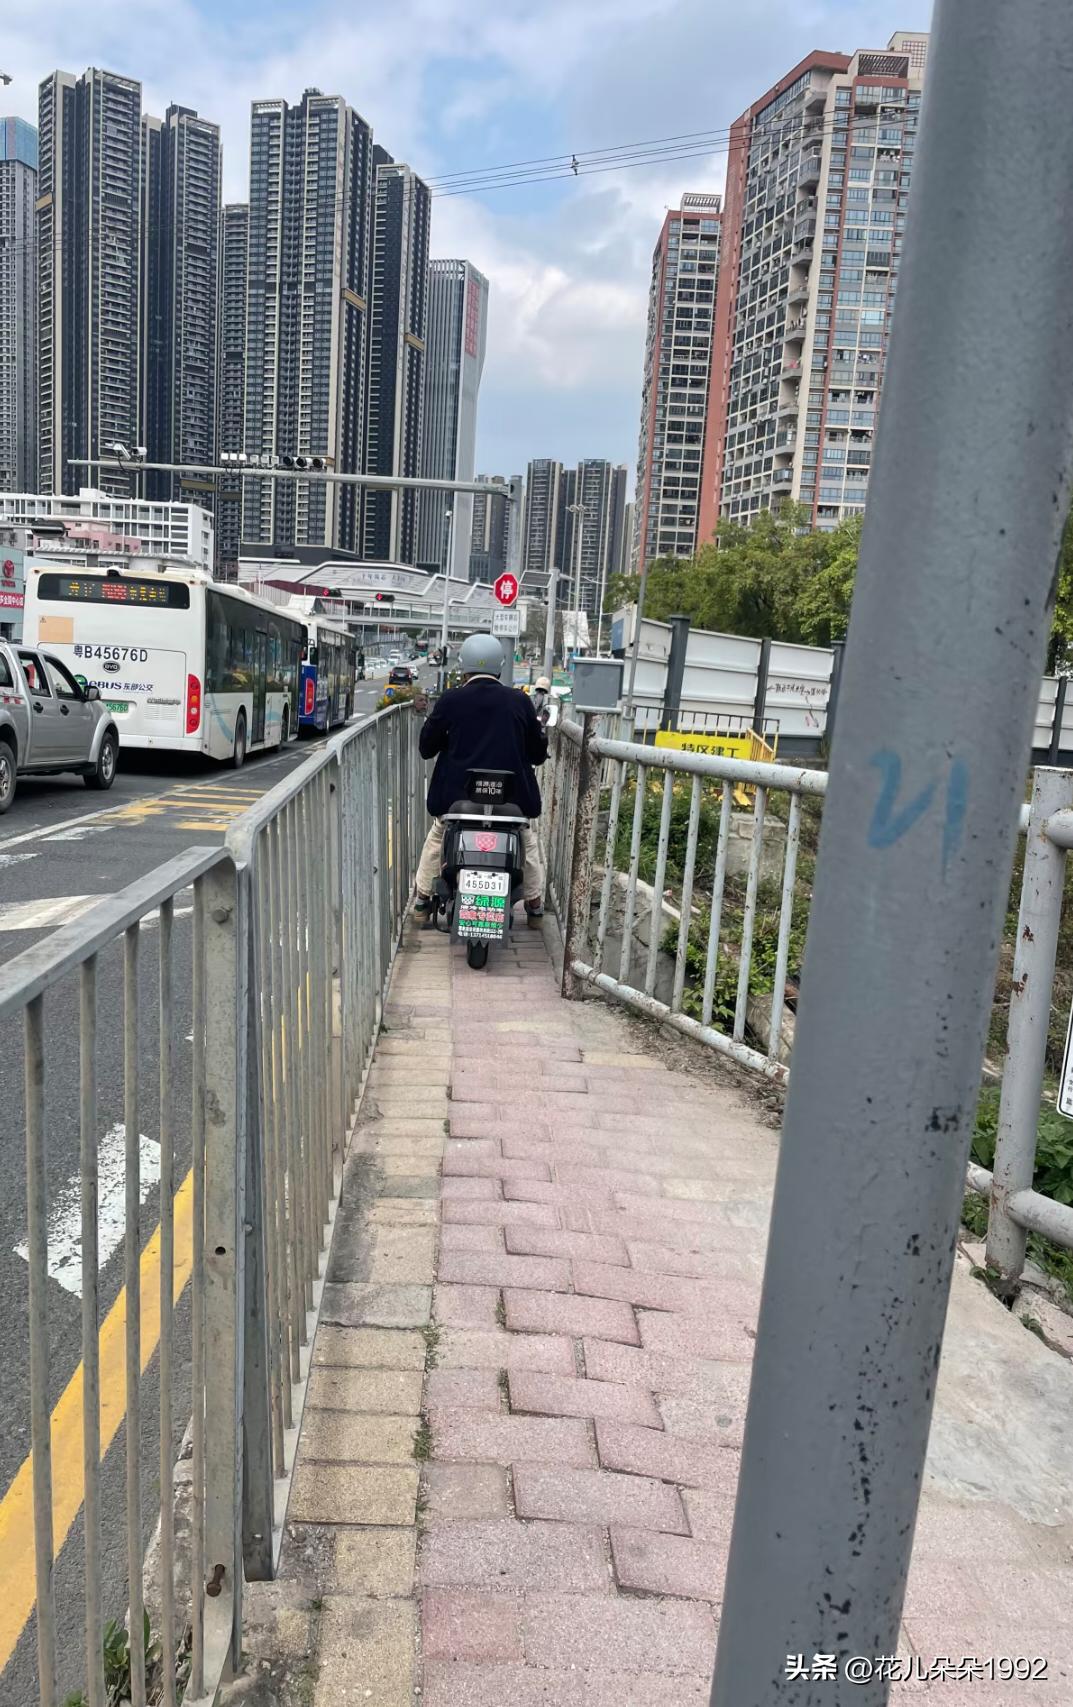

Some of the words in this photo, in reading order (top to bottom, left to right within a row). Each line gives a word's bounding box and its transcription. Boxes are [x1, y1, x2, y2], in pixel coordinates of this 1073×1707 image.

[500, 580, 514, 600] 停
[73, 644, 149, 663] 粤B45676D
[122, 682, 154, 692] 东部公交
[681, 742, 740, 759] 特区建工
[475, 895, 505, 908] 绿源
